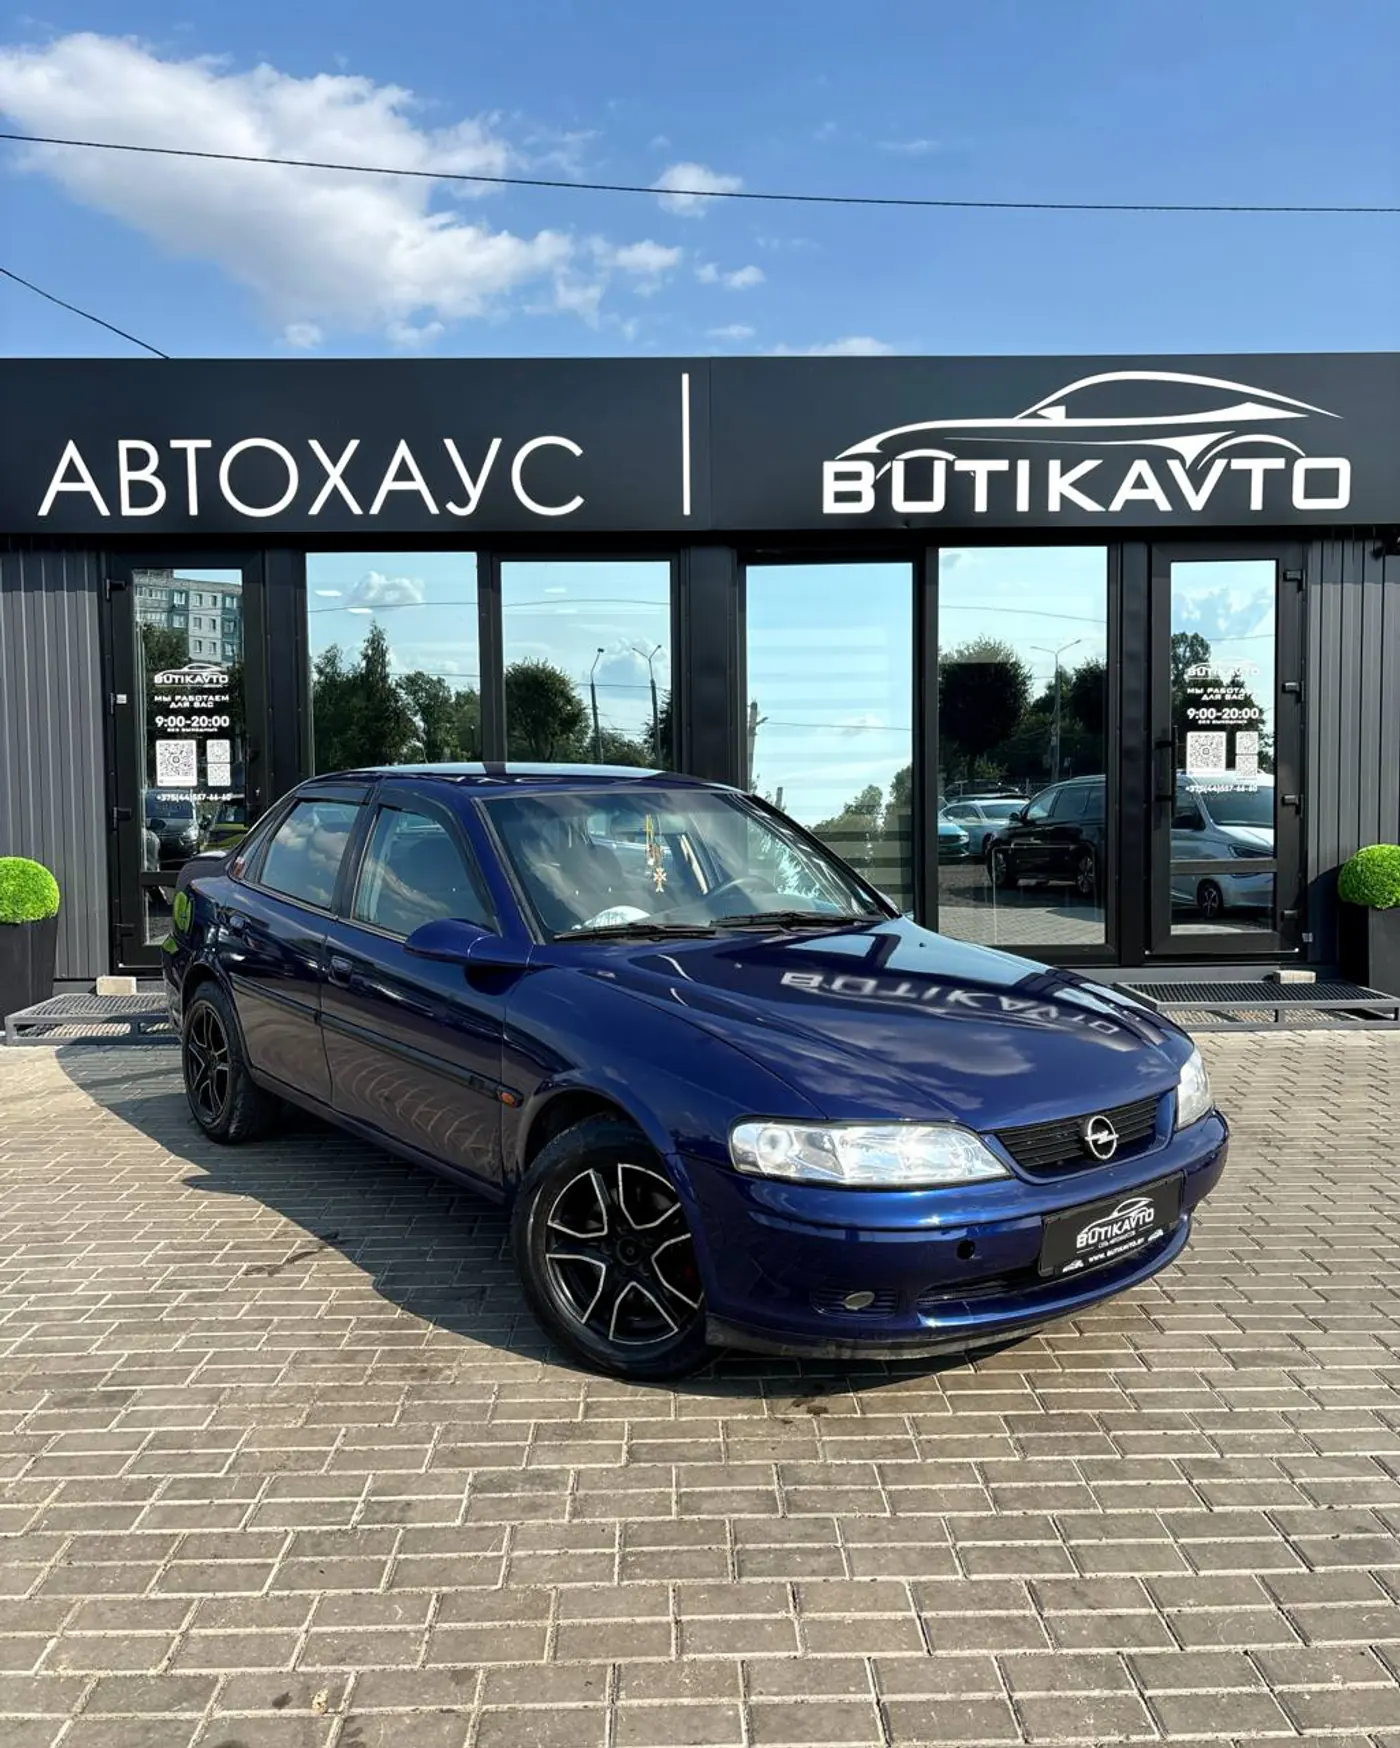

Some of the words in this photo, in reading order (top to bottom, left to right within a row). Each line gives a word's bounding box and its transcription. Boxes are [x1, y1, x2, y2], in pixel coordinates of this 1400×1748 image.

[37, 435, 585, 518] АВТОХАУС
[822, 456, 1351, 514] BUTIKAVTO
[1187, 667, 1260, 676] BUTIVTO
[169, 701, 190, 709] ДЛЯ
[1186, 707, 1259, 719] 9:00-20:00
[155, 715, 230, 728] 9:00-20:00
[1076, 1207, 1155, 1249] BUTIKAVTO
